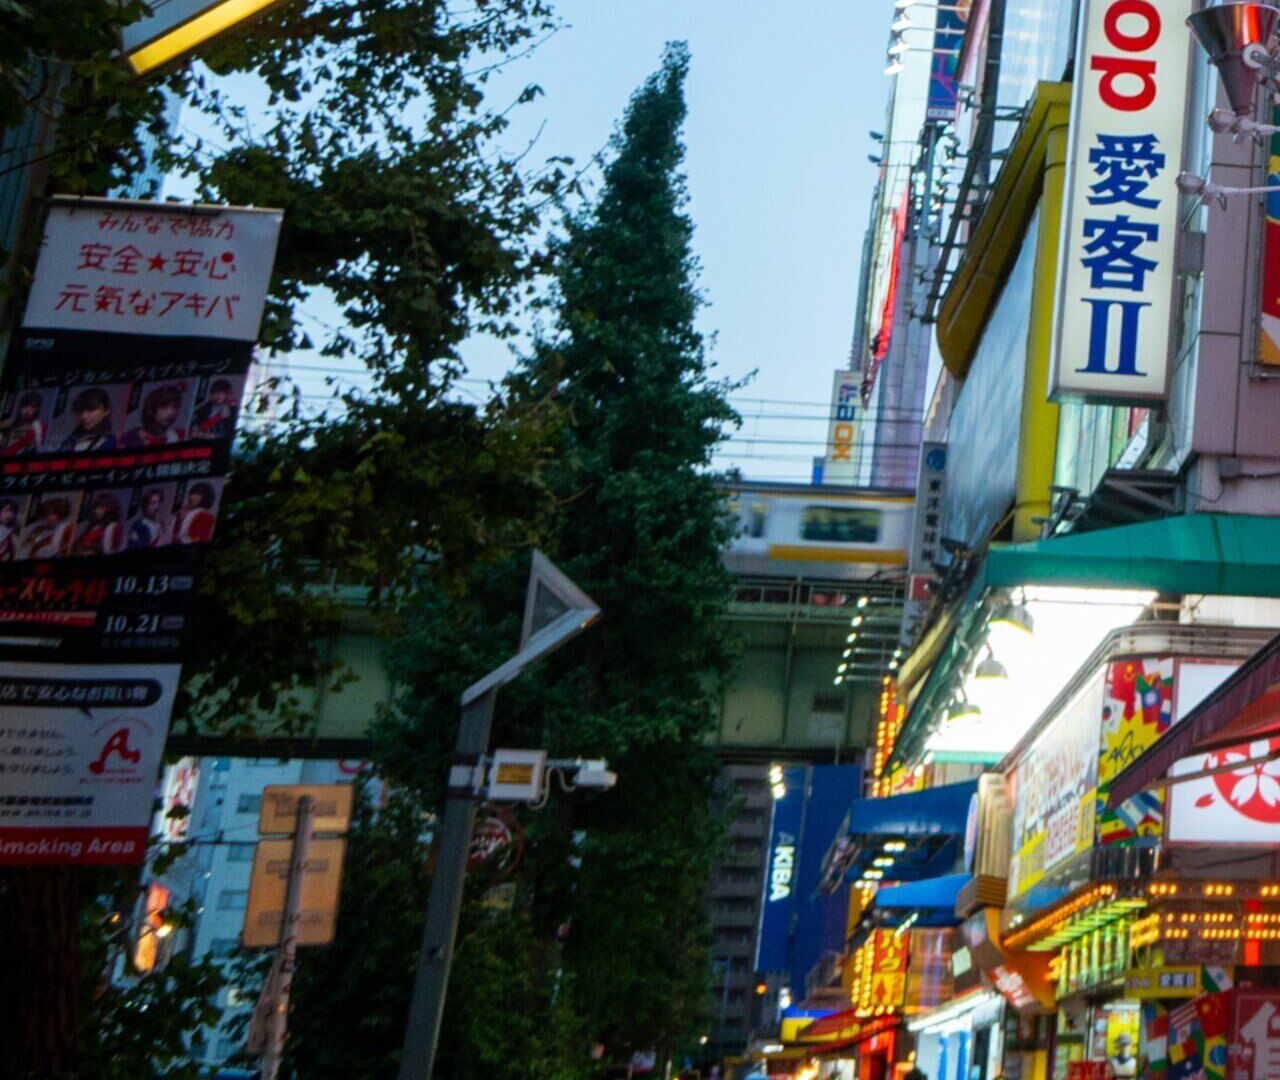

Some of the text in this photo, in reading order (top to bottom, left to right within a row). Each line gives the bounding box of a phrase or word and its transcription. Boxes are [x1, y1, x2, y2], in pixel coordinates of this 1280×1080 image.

[98, 211, 235, 240] みんなで協力
[114, 575, 169, 595] 10.13
[104, 614, 161, 634] 10.21
[88, 838, 136, 853] Area
[769, 831, 797, 903] AKIBA
